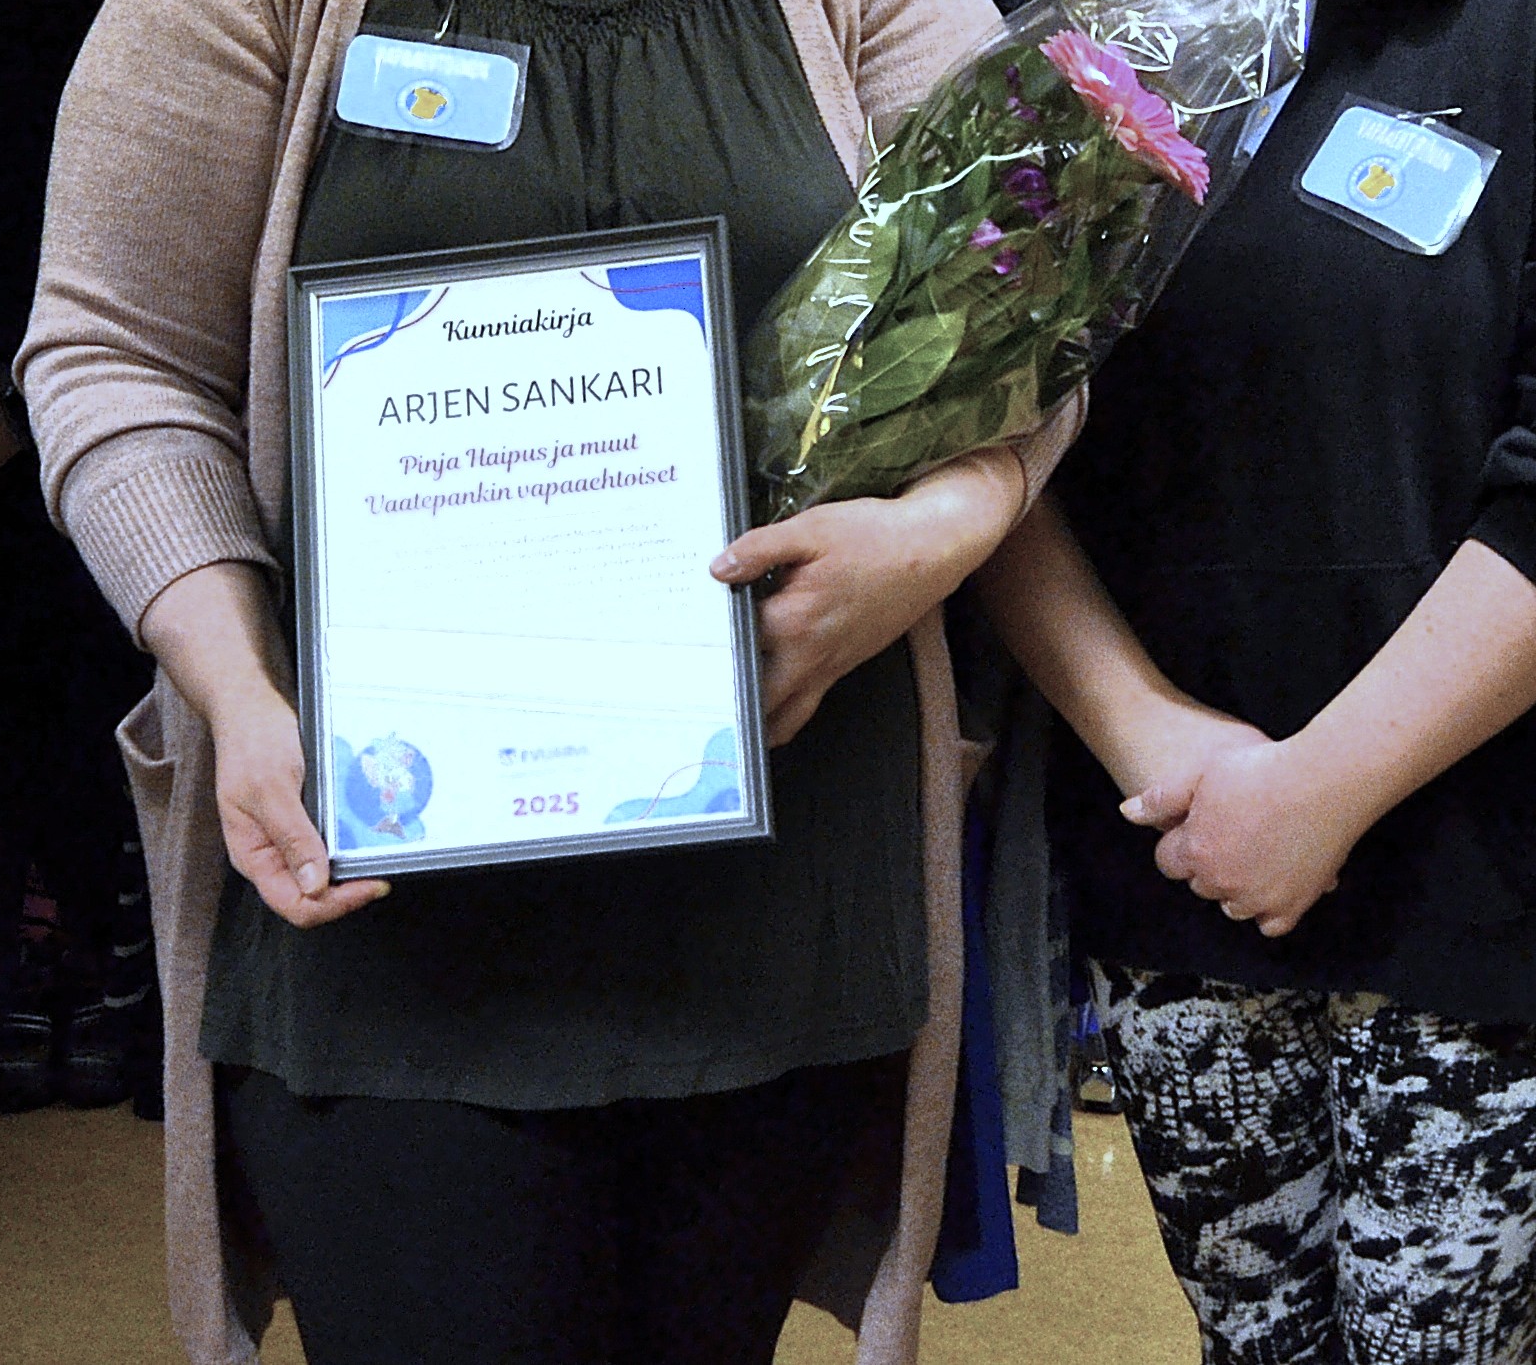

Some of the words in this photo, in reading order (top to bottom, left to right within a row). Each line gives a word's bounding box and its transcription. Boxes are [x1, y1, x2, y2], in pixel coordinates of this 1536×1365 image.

[443, 307, 594, 342] Kunniakirja
[378, 386, 490, 426] ARJEN
[502, 366, 663, 413] SANKARI
[399, 453, 461, 481] Pinja
[465, 443, 547, 473] Haipus
[547, 442, 574, 469] ja
[579, 433, 639, 456] muut
[365, 484, 512, 516] Vaatepankin
[517, 465, 678, 504] vapaaehtoiset
[512, 792, 580, 816] 2025
